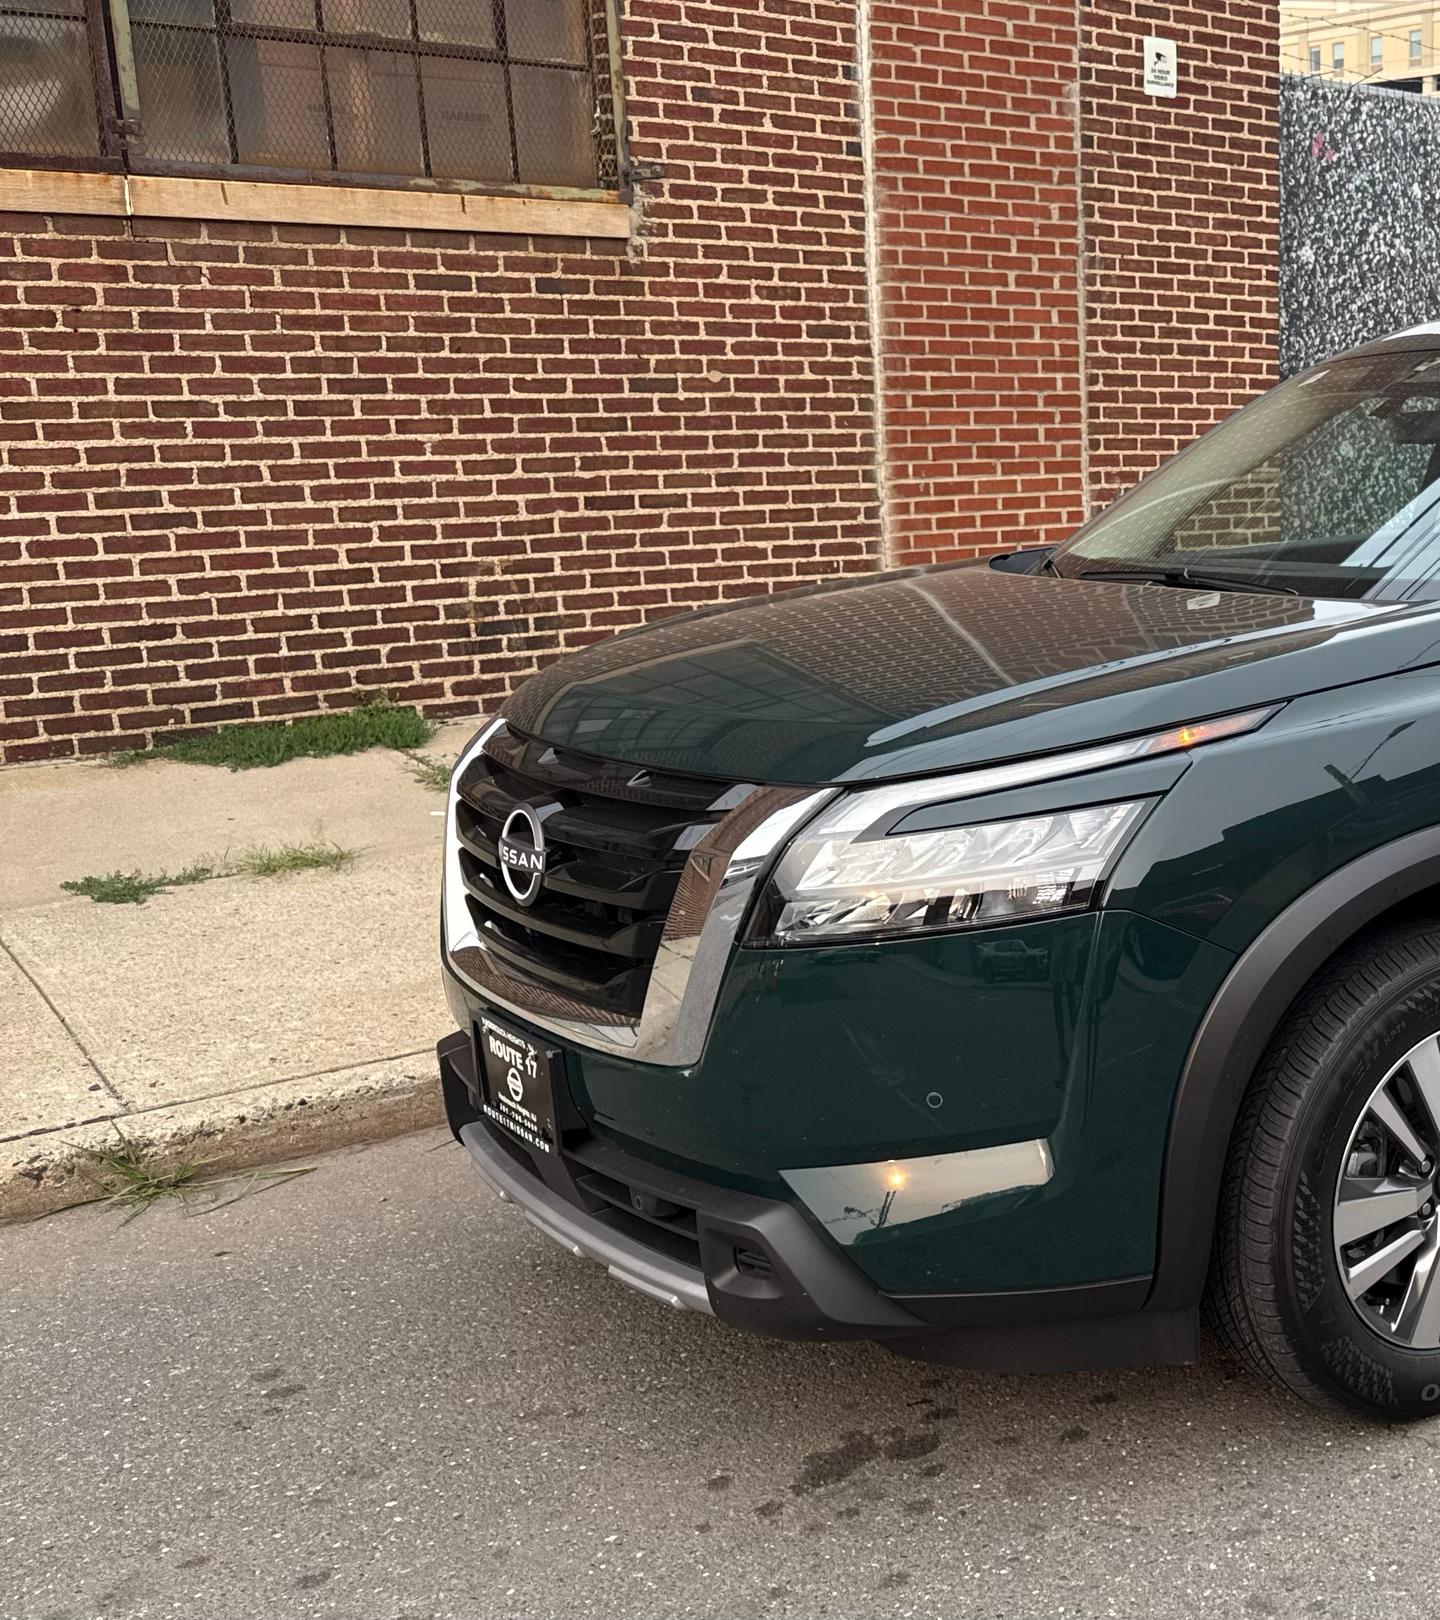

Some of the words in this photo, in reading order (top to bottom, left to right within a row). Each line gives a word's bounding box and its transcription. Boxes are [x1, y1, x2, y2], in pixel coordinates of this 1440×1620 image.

[502, 845, 543, 870] SSAN
[489, 1035, 524, 1071] ROUTE
[525, 1057, 537, 1079] 17
